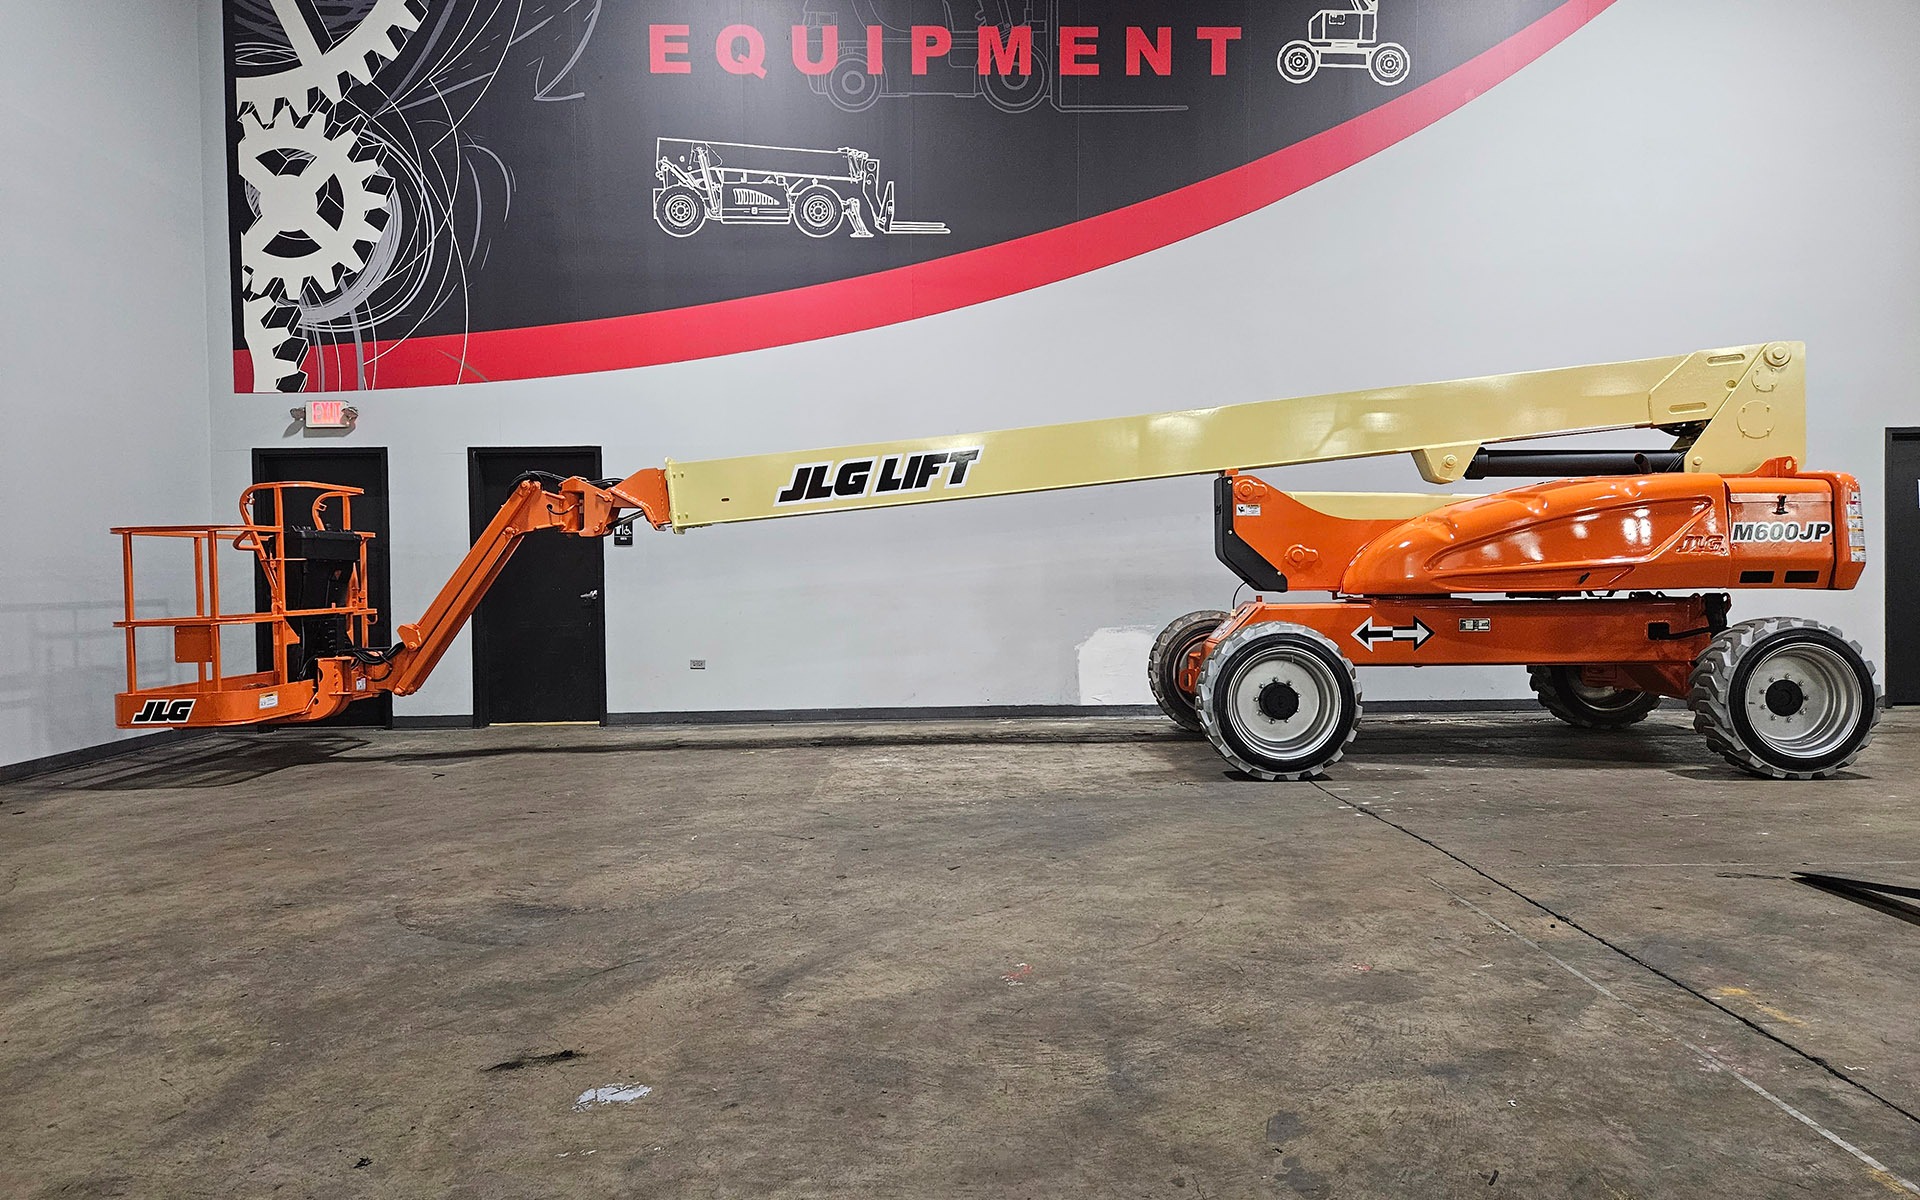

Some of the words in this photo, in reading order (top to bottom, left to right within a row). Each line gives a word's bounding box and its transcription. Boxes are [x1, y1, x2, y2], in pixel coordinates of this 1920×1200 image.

[649, 24, 1242, 79] EQUIPMENT
[312, 402, 341, 423] EXIT
[777, 460, 875, 503] JLG
[874, 449, 980, 493] LIFT
[1732, 522, 1831, 542] M600JP
[132, 700, 195, 723] JLG
